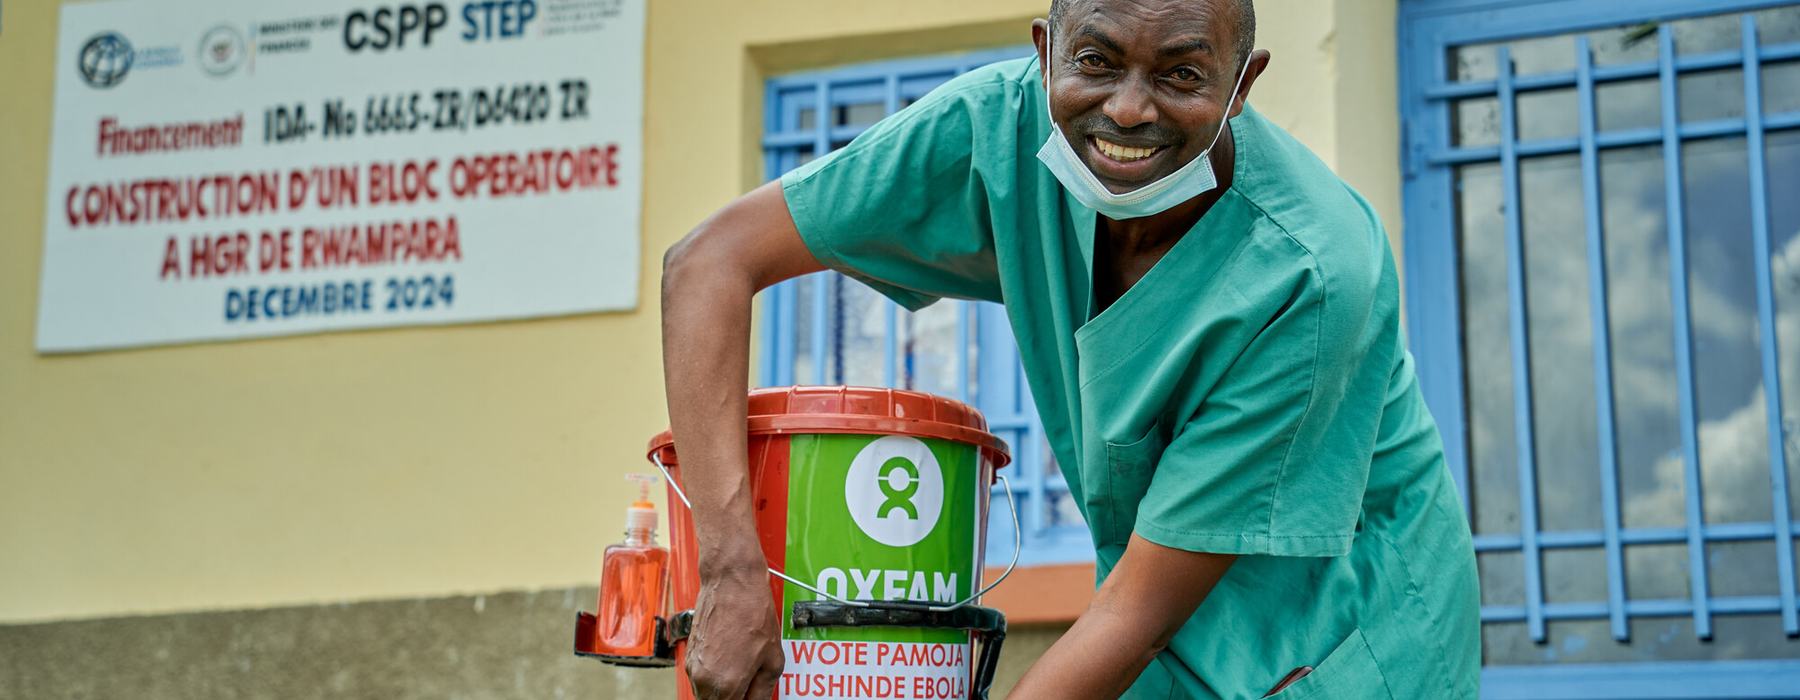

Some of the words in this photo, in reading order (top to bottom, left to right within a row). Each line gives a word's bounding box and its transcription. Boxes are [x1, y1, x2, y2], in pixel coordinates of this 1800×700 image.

[343, 3, 448, 52] CSPP
[461, 0, 537, 41] STEP
[97, 115, 244, 157] Financement
[264, 103, 316, 144] IDA-
[559, 79, 589, 119] ZR
[66, 171, 280, 228] CONSTRUCTION
[287, 166, 359, 211] D'UN
[368, 159, 439, 204] BLOC
[449, 144, 619, 196] OPERATOIRE
[160, 236, 181, 280] A
[190, 231, 250, 277] HGR
[259, 229, 293, 273] DE
[301, 215, 462, 269] RWAMPARA
[225, 280, 372, 321] DECEMBRE
[386, 275, 454, 311] 2024
[816, 567, 957, 603] OXFAM
[791, 641, 868, 665] WOTE
[877, 643, 964, 667] PAMOJA
[782, 674, 905, 698] TUSHINDE
[913, 677, 964, 699] EBOLA
